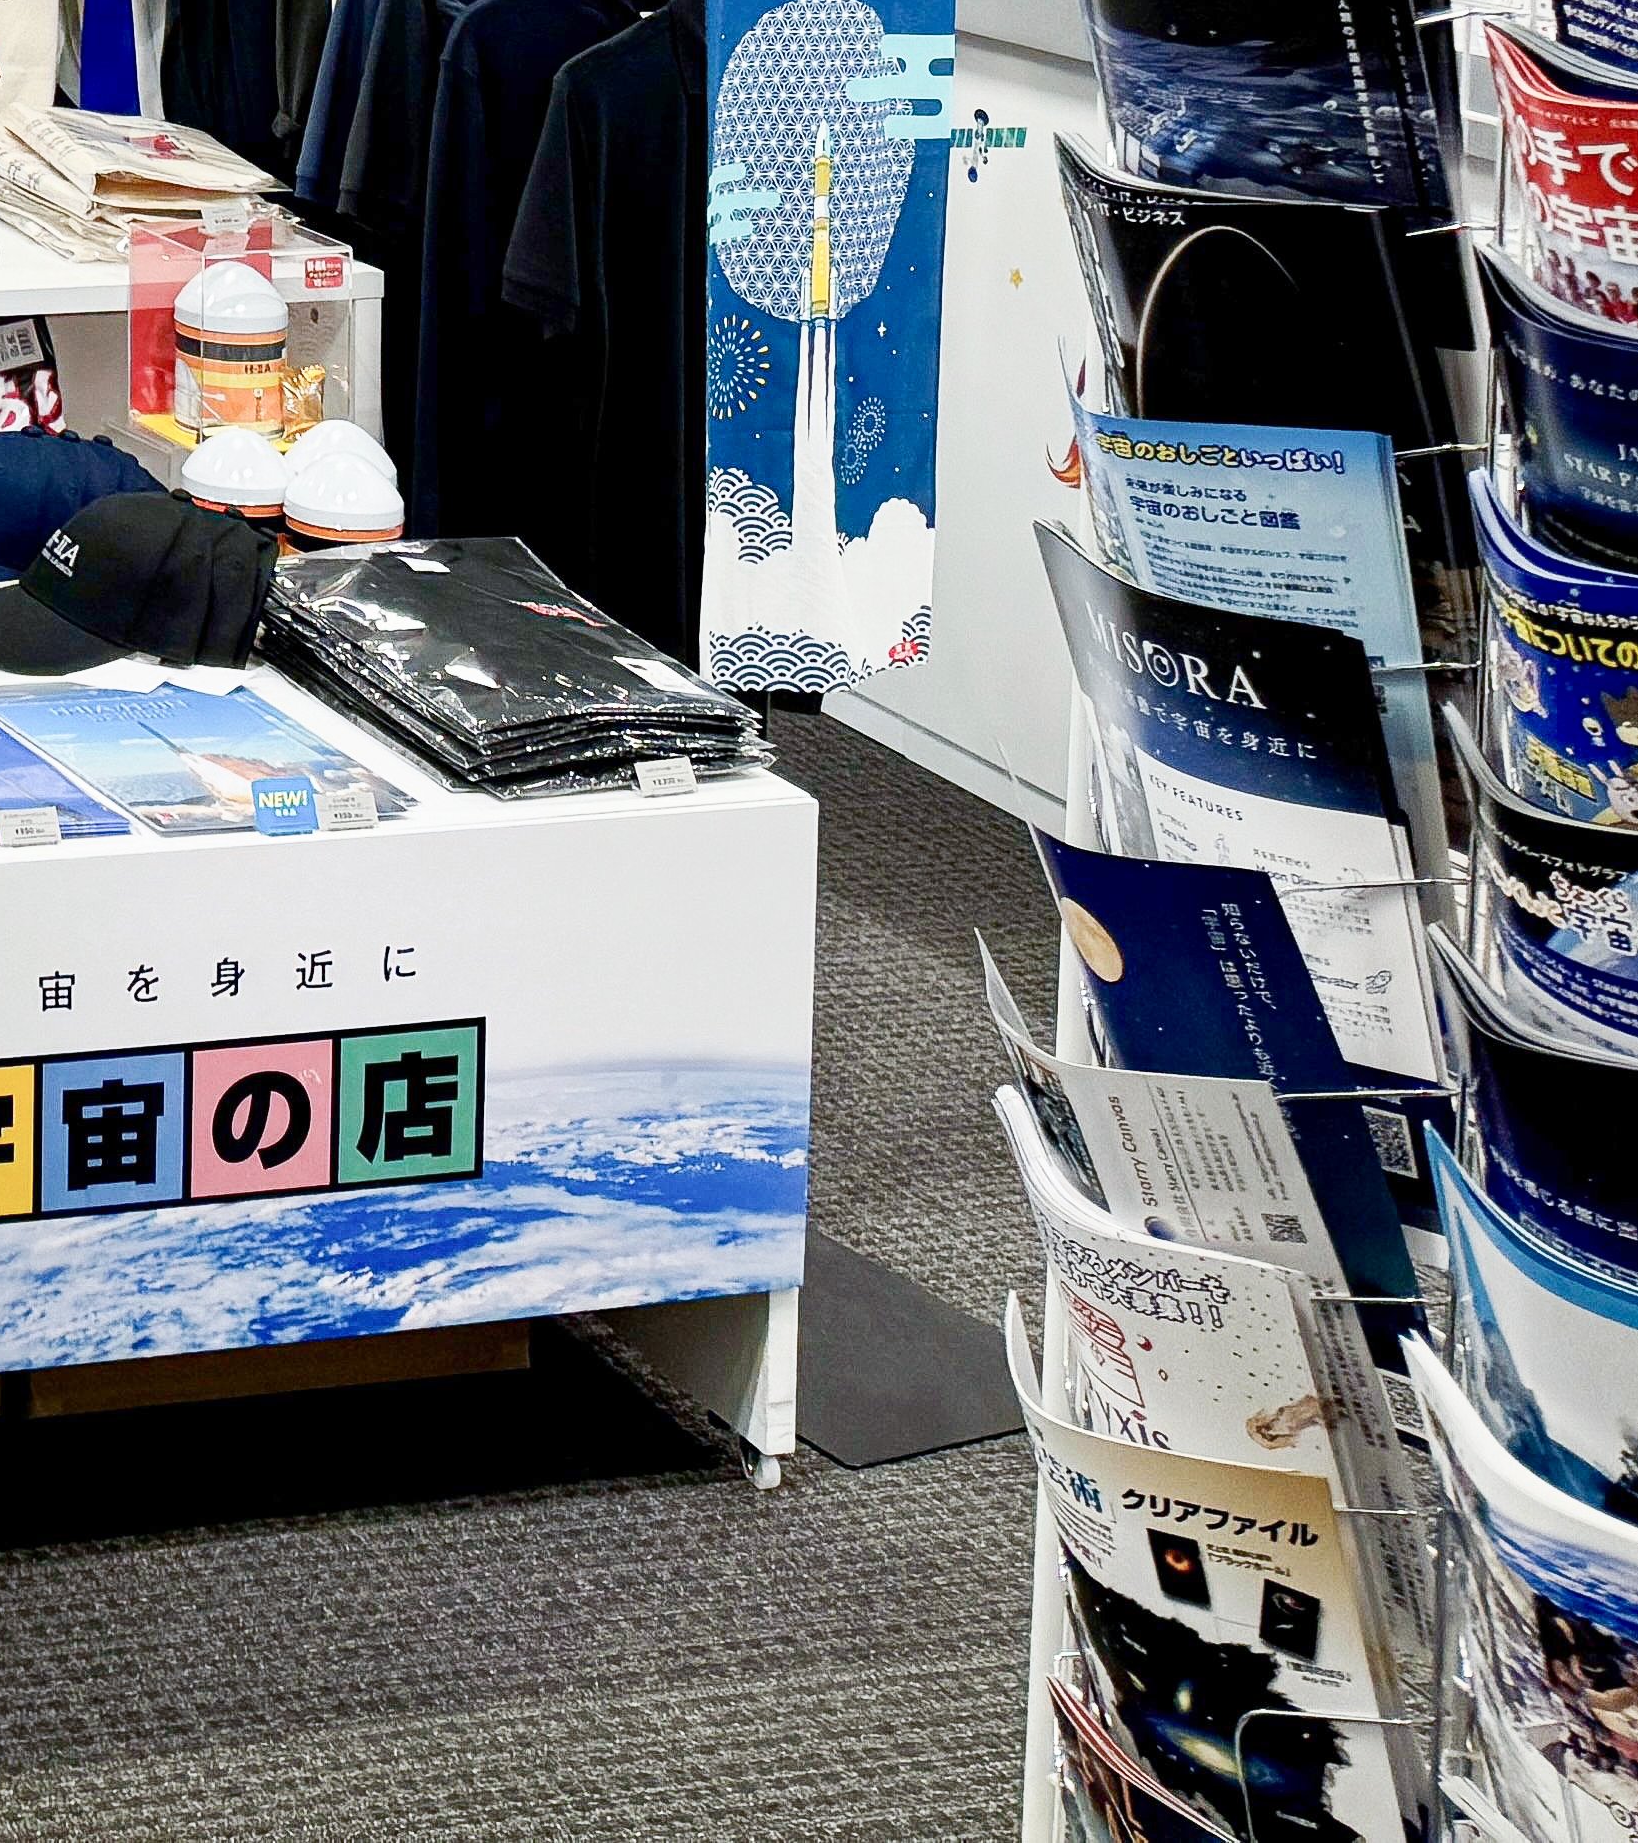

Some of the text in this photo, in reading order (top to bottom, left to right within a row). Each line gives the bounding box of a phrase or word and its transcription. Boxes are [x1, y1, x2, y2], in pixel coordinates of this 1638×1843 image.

[1094, 429, 1345, 474] 宇宙のおしごといっぱい！
[1129, 496, 1301, 531] 宇宙のおしごと図鑑
[256, 789, 308, 809] NEW!
[1173, 786, 1244, 822] FEATURES
[1108, 1096, 1138, 1153] Canvas
[1121, 1488, 1319, 1547] クリアファイル
